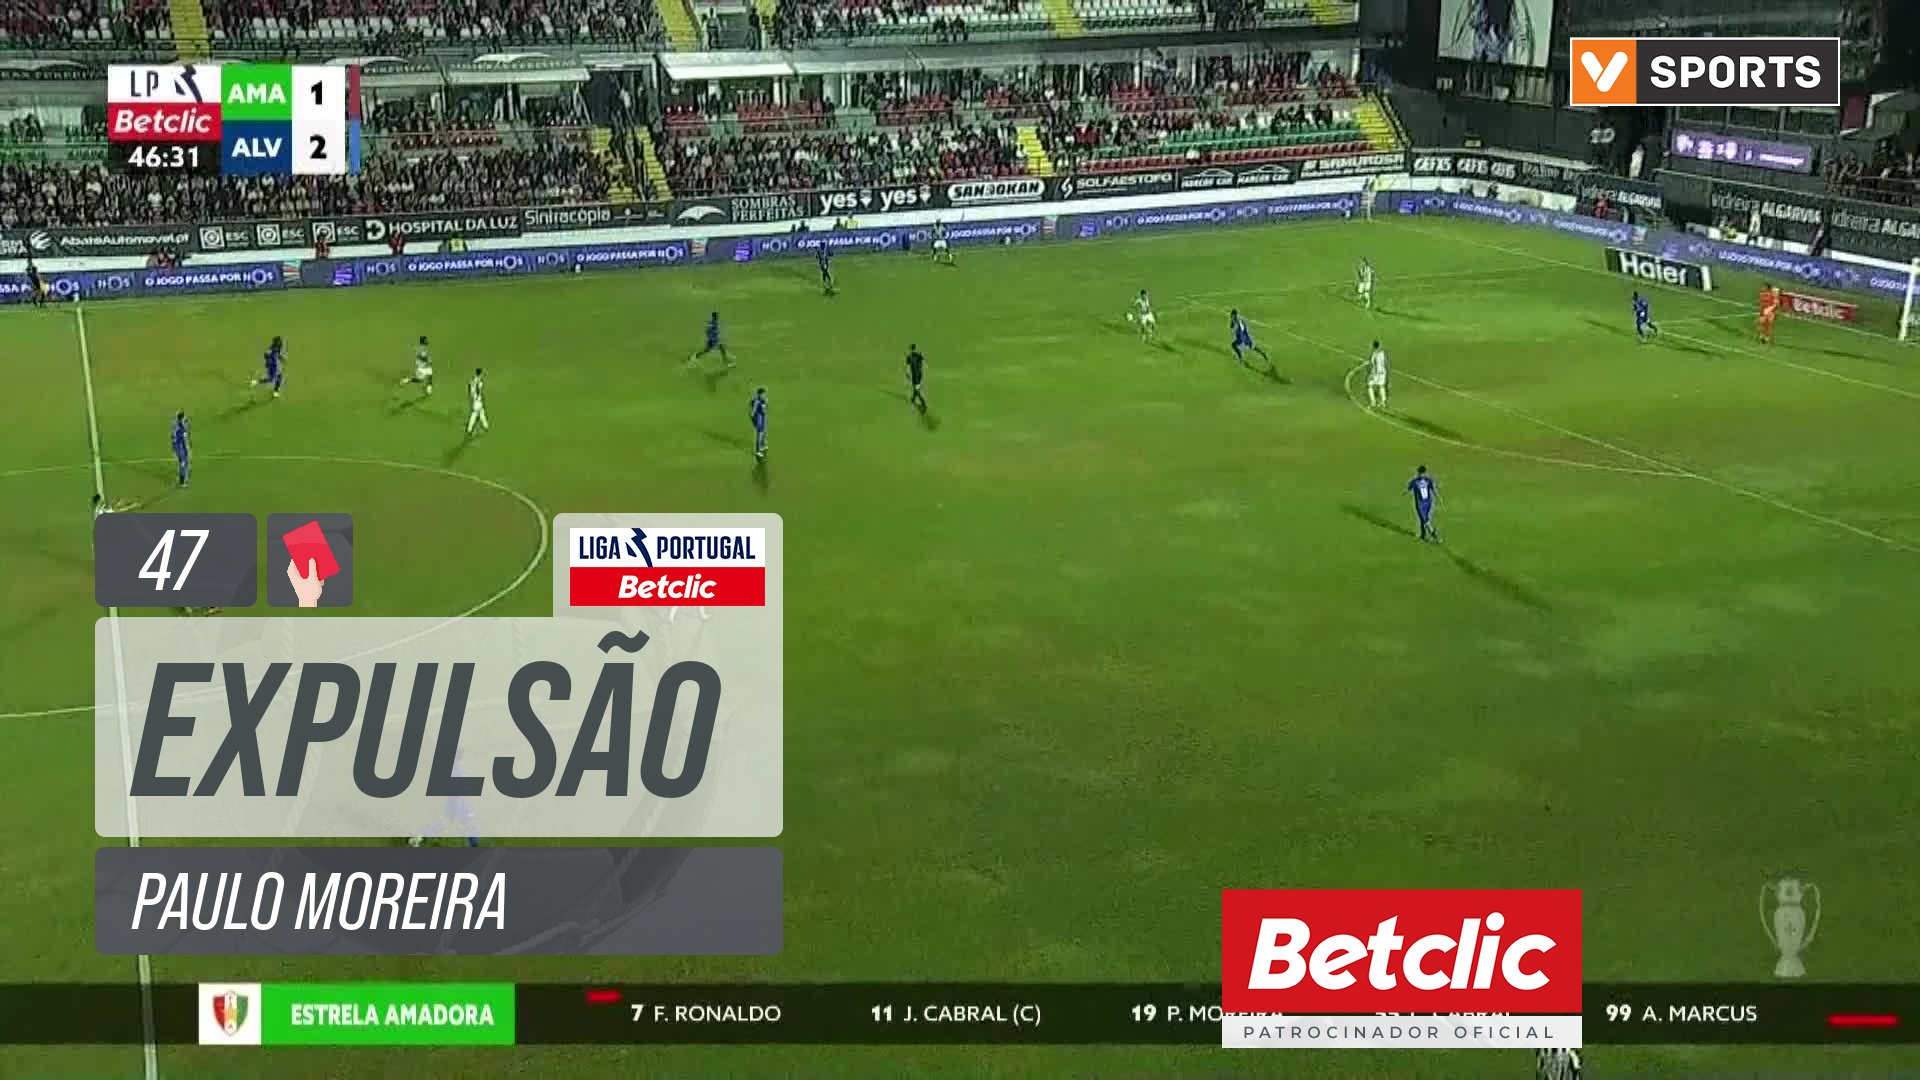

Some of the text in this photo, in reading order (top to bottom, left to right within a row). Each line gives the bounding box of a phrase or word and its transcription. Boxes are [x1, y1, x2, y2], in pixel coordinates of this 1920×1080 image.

[731, 196, 796, 210] SOMBRAS
[820, 192, 857, 215] yes
[880, 188, 917, 211] yes
[732, 207, 804, 221] PERFEITAS
[389, 216, 518, 235] HOSPITAL DA LUZ
[418, 262, 443, 271] JOGO
[445, 260, 473, 270] PASSA
[475, 259, 494, 268] POR
[1619, 251, 1687, 286] Haier
[145, 277, 154, 286] O
[156, 275, 184, 286] JOGO
[186, 274, 217, 284] PASSA
[219, 274, 242, 283] POR
